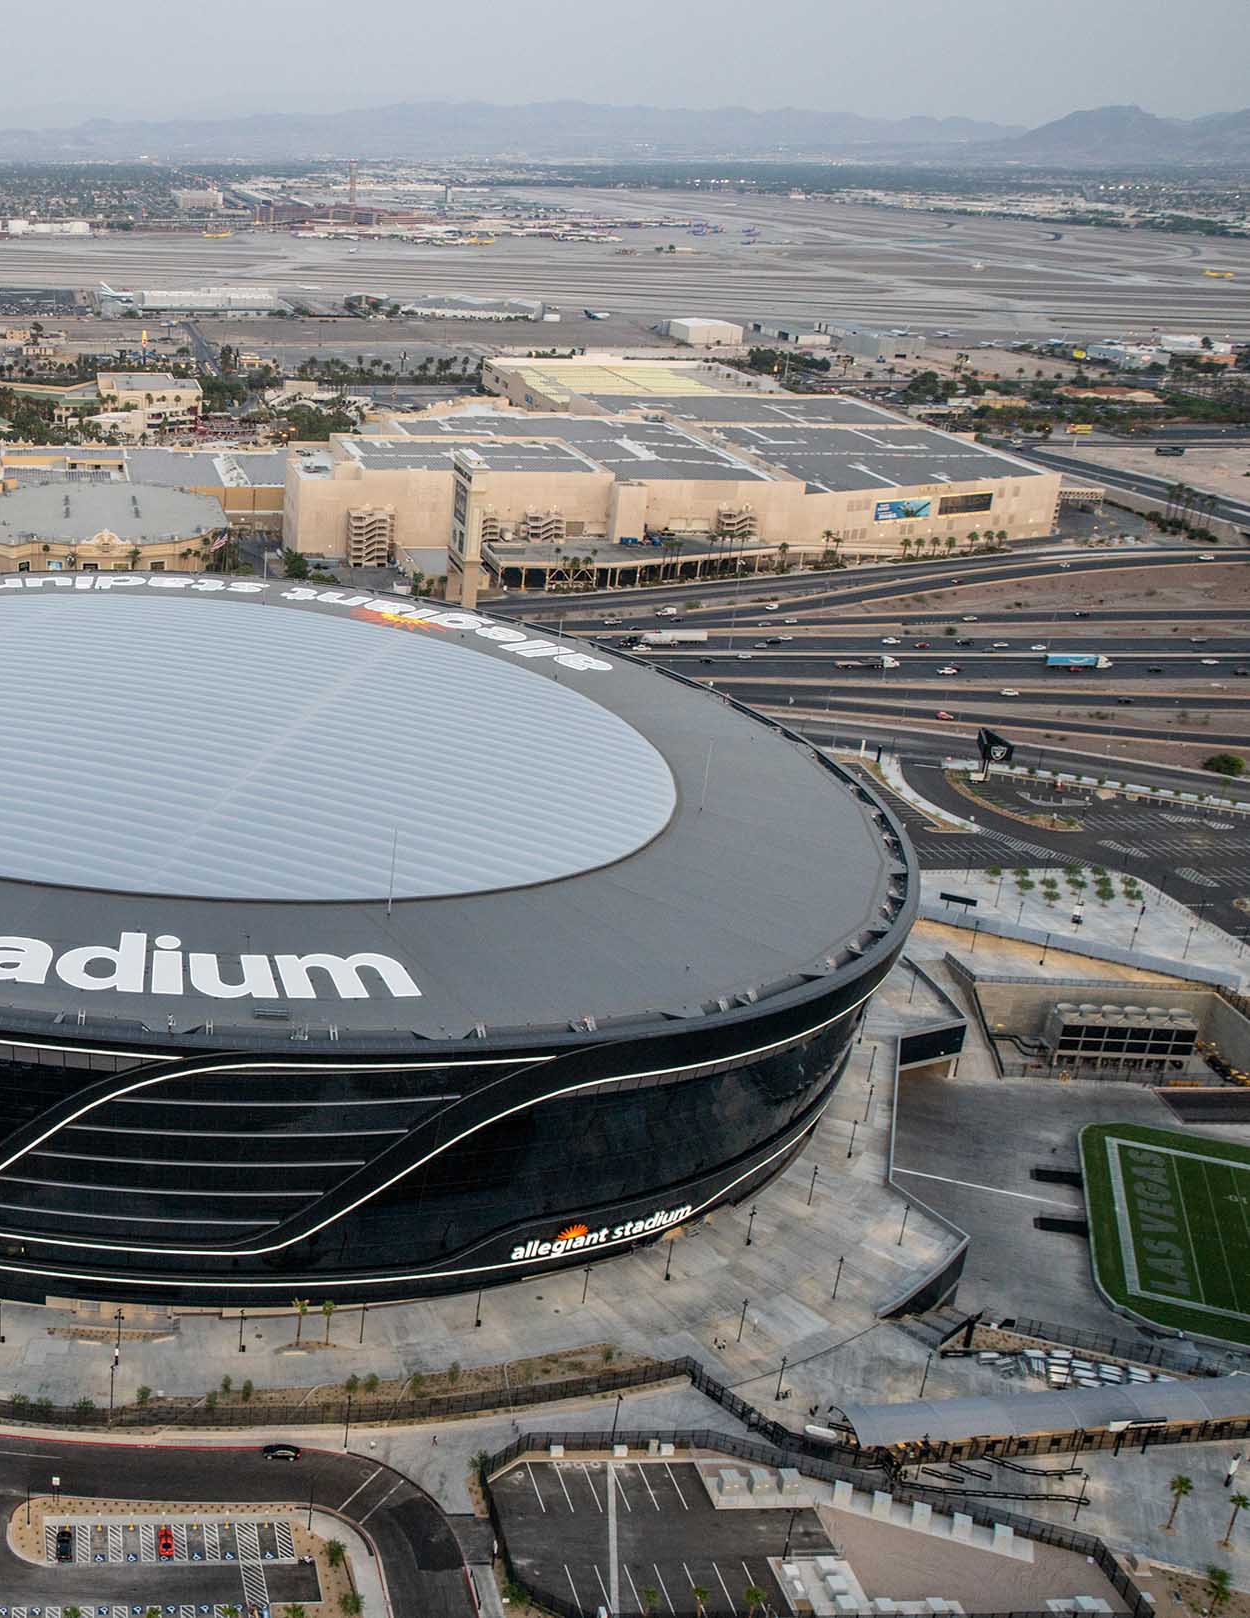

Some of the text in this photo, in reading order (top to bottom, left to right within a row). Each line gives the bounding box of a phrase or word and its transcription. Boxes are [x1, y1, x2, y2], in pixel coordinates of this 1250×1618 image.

[280, 587, 613, 671] allegiant
[510, 1205, 693, 1261] allegiant stadium
[1128, 1149, 1191, 1296] LAS VEGAS
